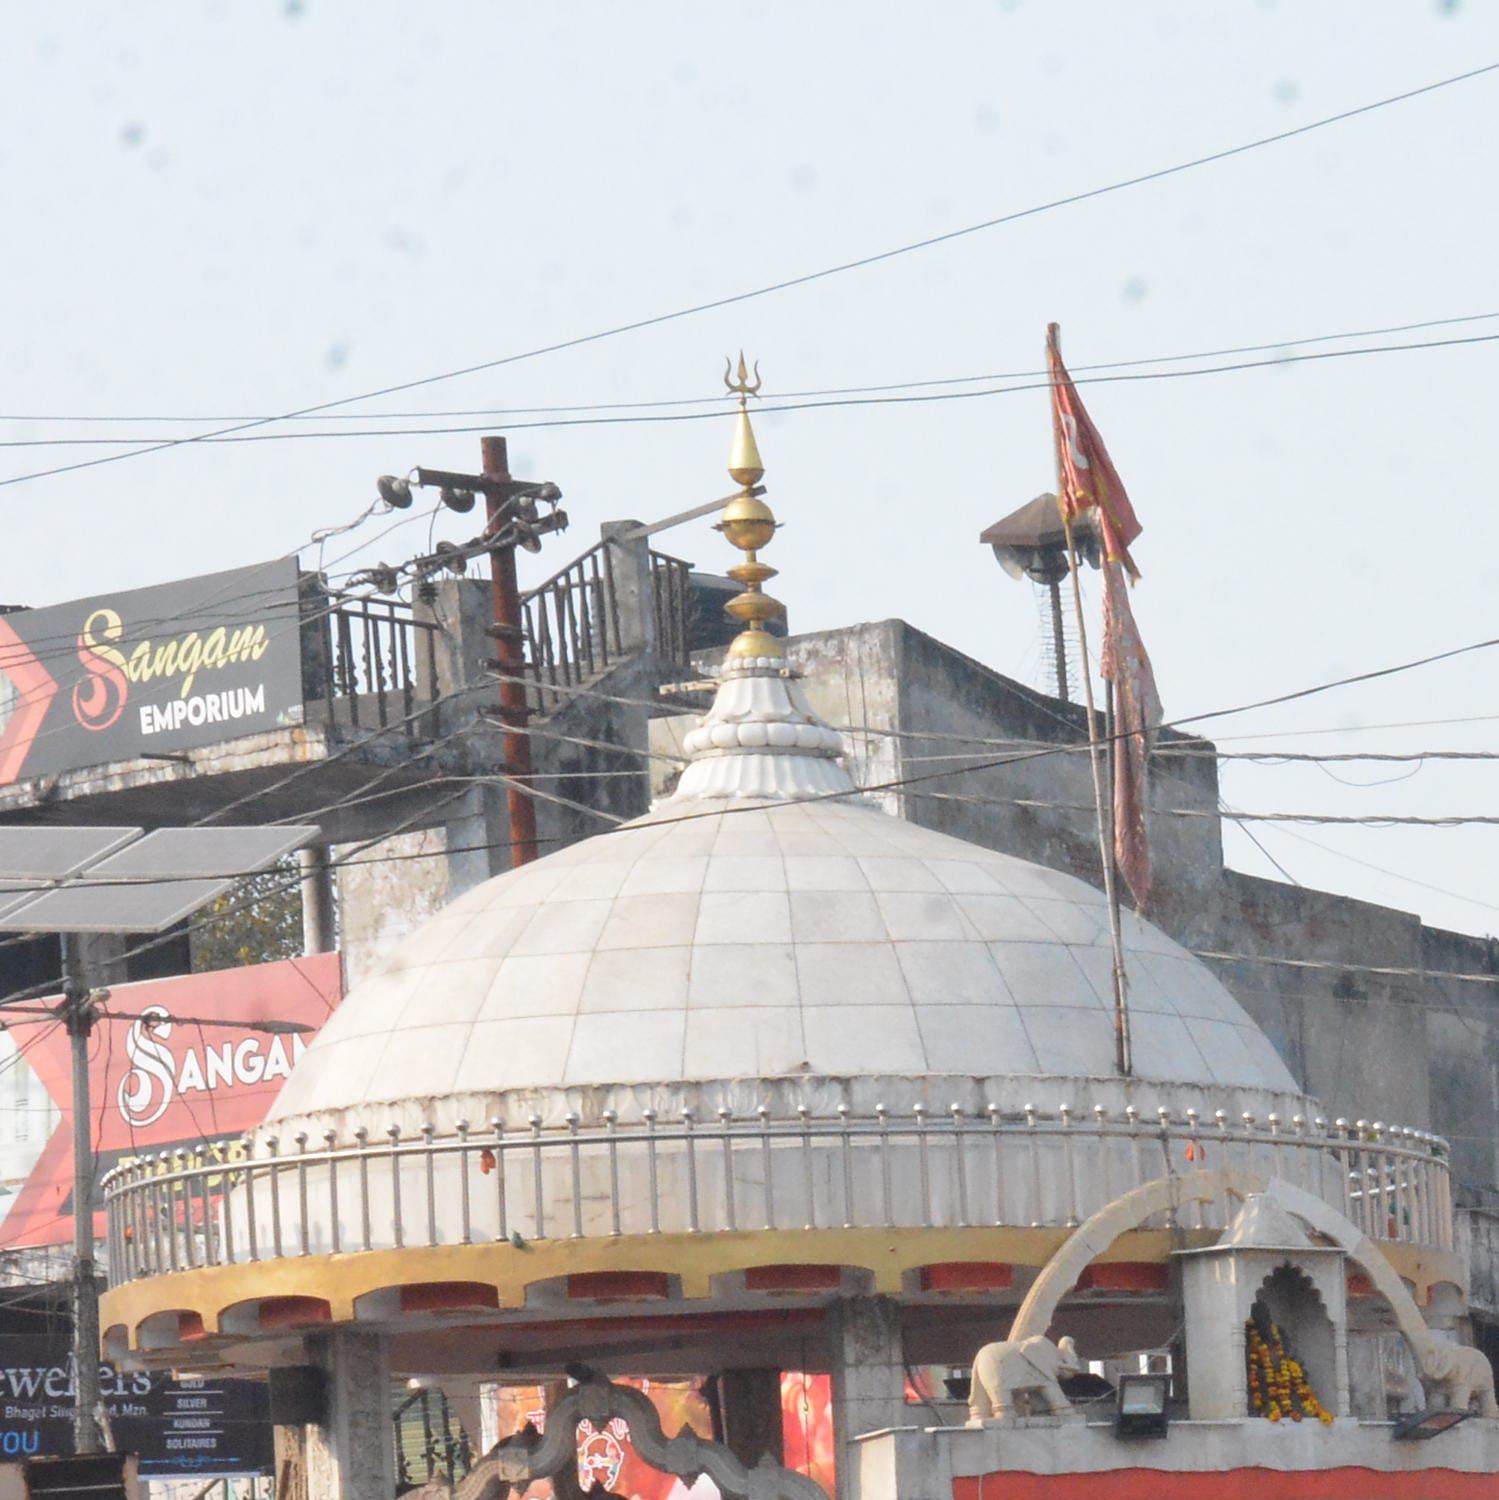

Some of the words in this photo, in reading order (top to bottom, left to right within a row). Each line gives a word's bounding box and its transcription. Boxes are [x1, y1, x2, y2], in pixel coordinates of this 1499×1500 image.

[72, 609, 269, 730] Sangam
[139, 684, 265, 735] EMPORIUM
[177, 1398, 207, 1410] SILVER
[166, 1438, 217, 1450] SOLITAIRES
